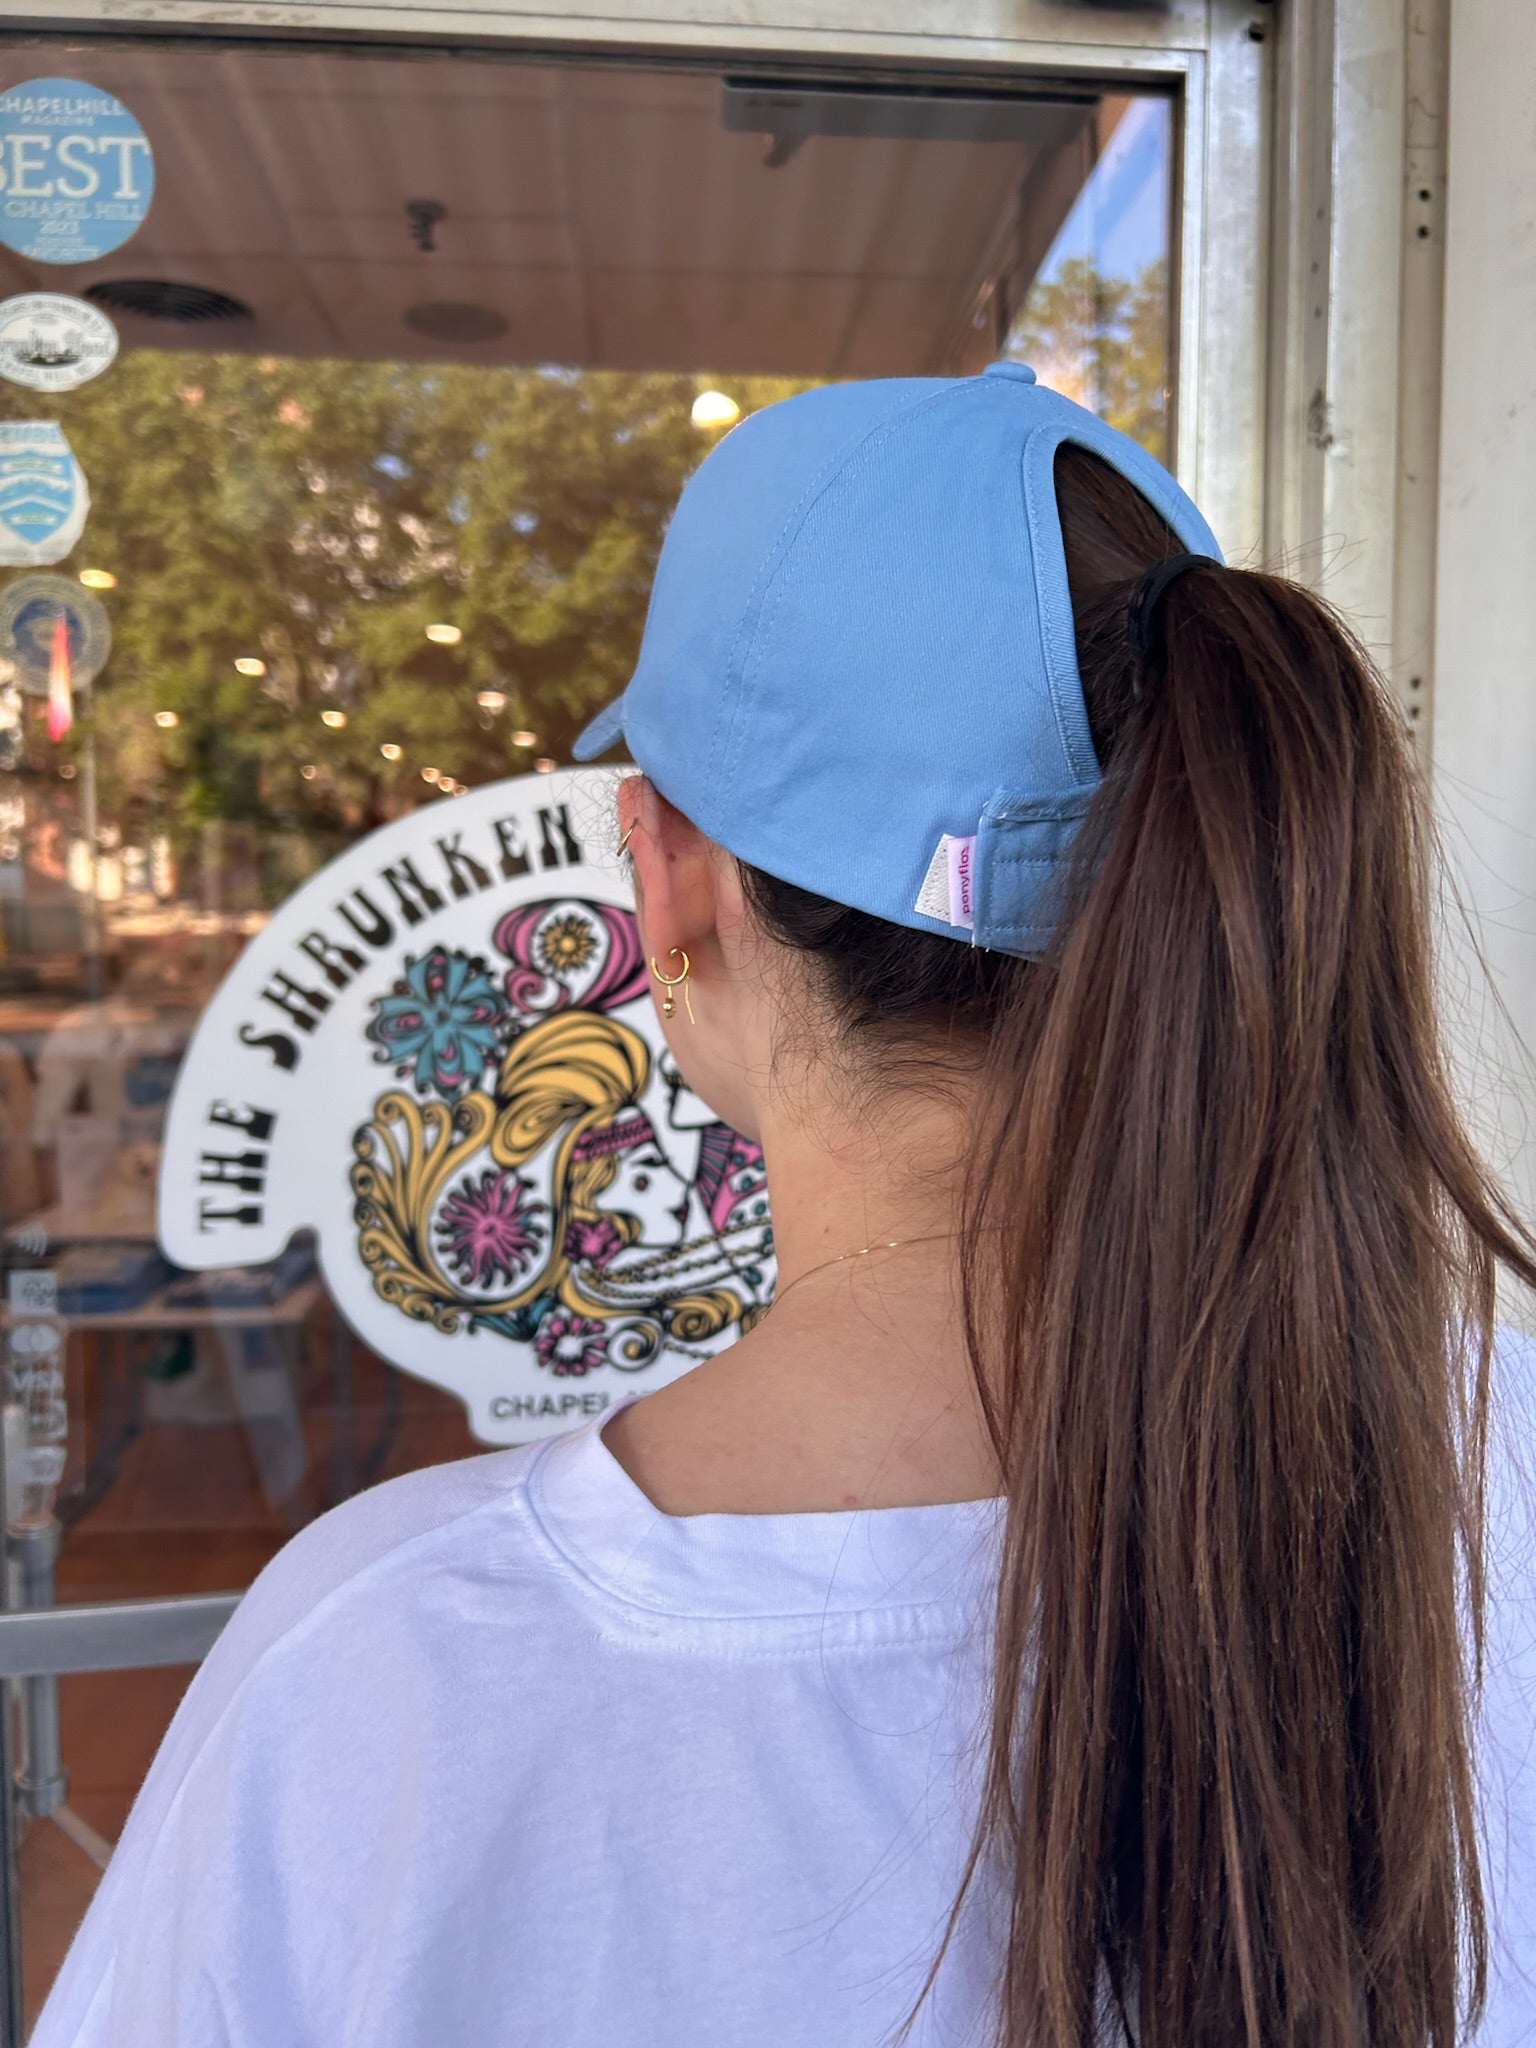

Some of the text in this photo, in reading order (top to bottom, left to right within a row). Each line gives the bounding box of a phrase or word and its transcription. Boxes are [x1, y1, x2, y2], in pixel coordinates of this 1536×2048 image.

[0, 134, 152, 199] EST
[198, 803, 584, 1235] THE SHRUNKEN
